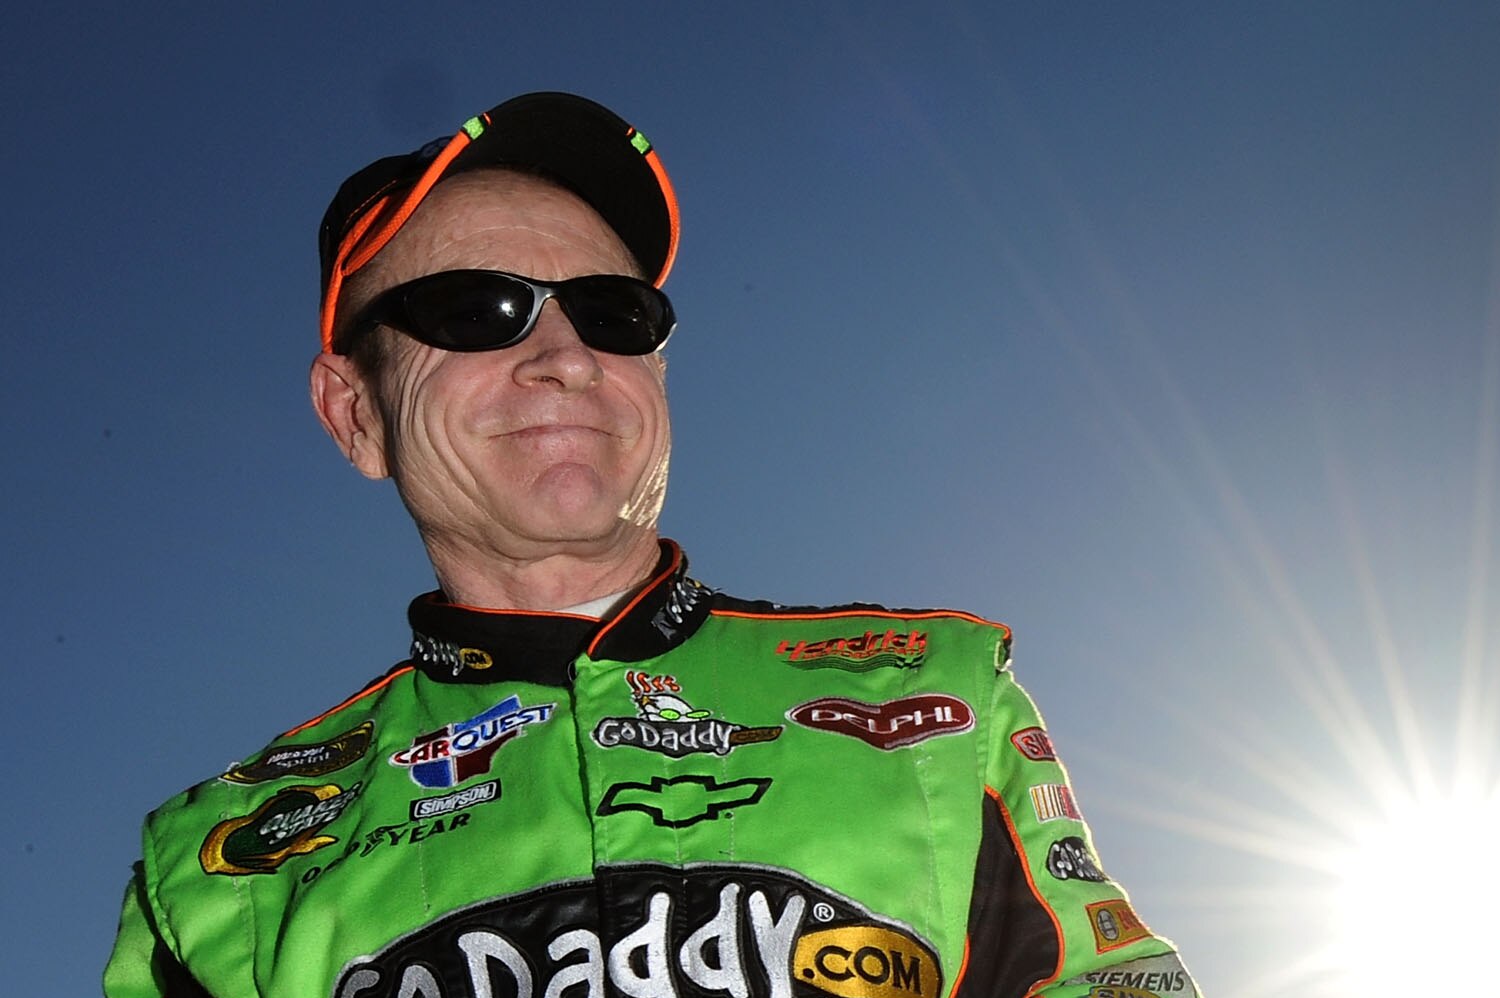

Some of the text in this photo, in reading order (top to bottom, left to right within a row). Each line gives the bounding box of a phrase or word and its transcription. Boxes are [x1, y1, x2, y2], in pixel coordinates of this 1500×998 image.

[810, 705, 953, 734] DELPHI
[419, 785, 493, 817] SIMPSON
[802, 945, 924, 996] .COM
[1084, 969, 1185, 993] SIEMENS
